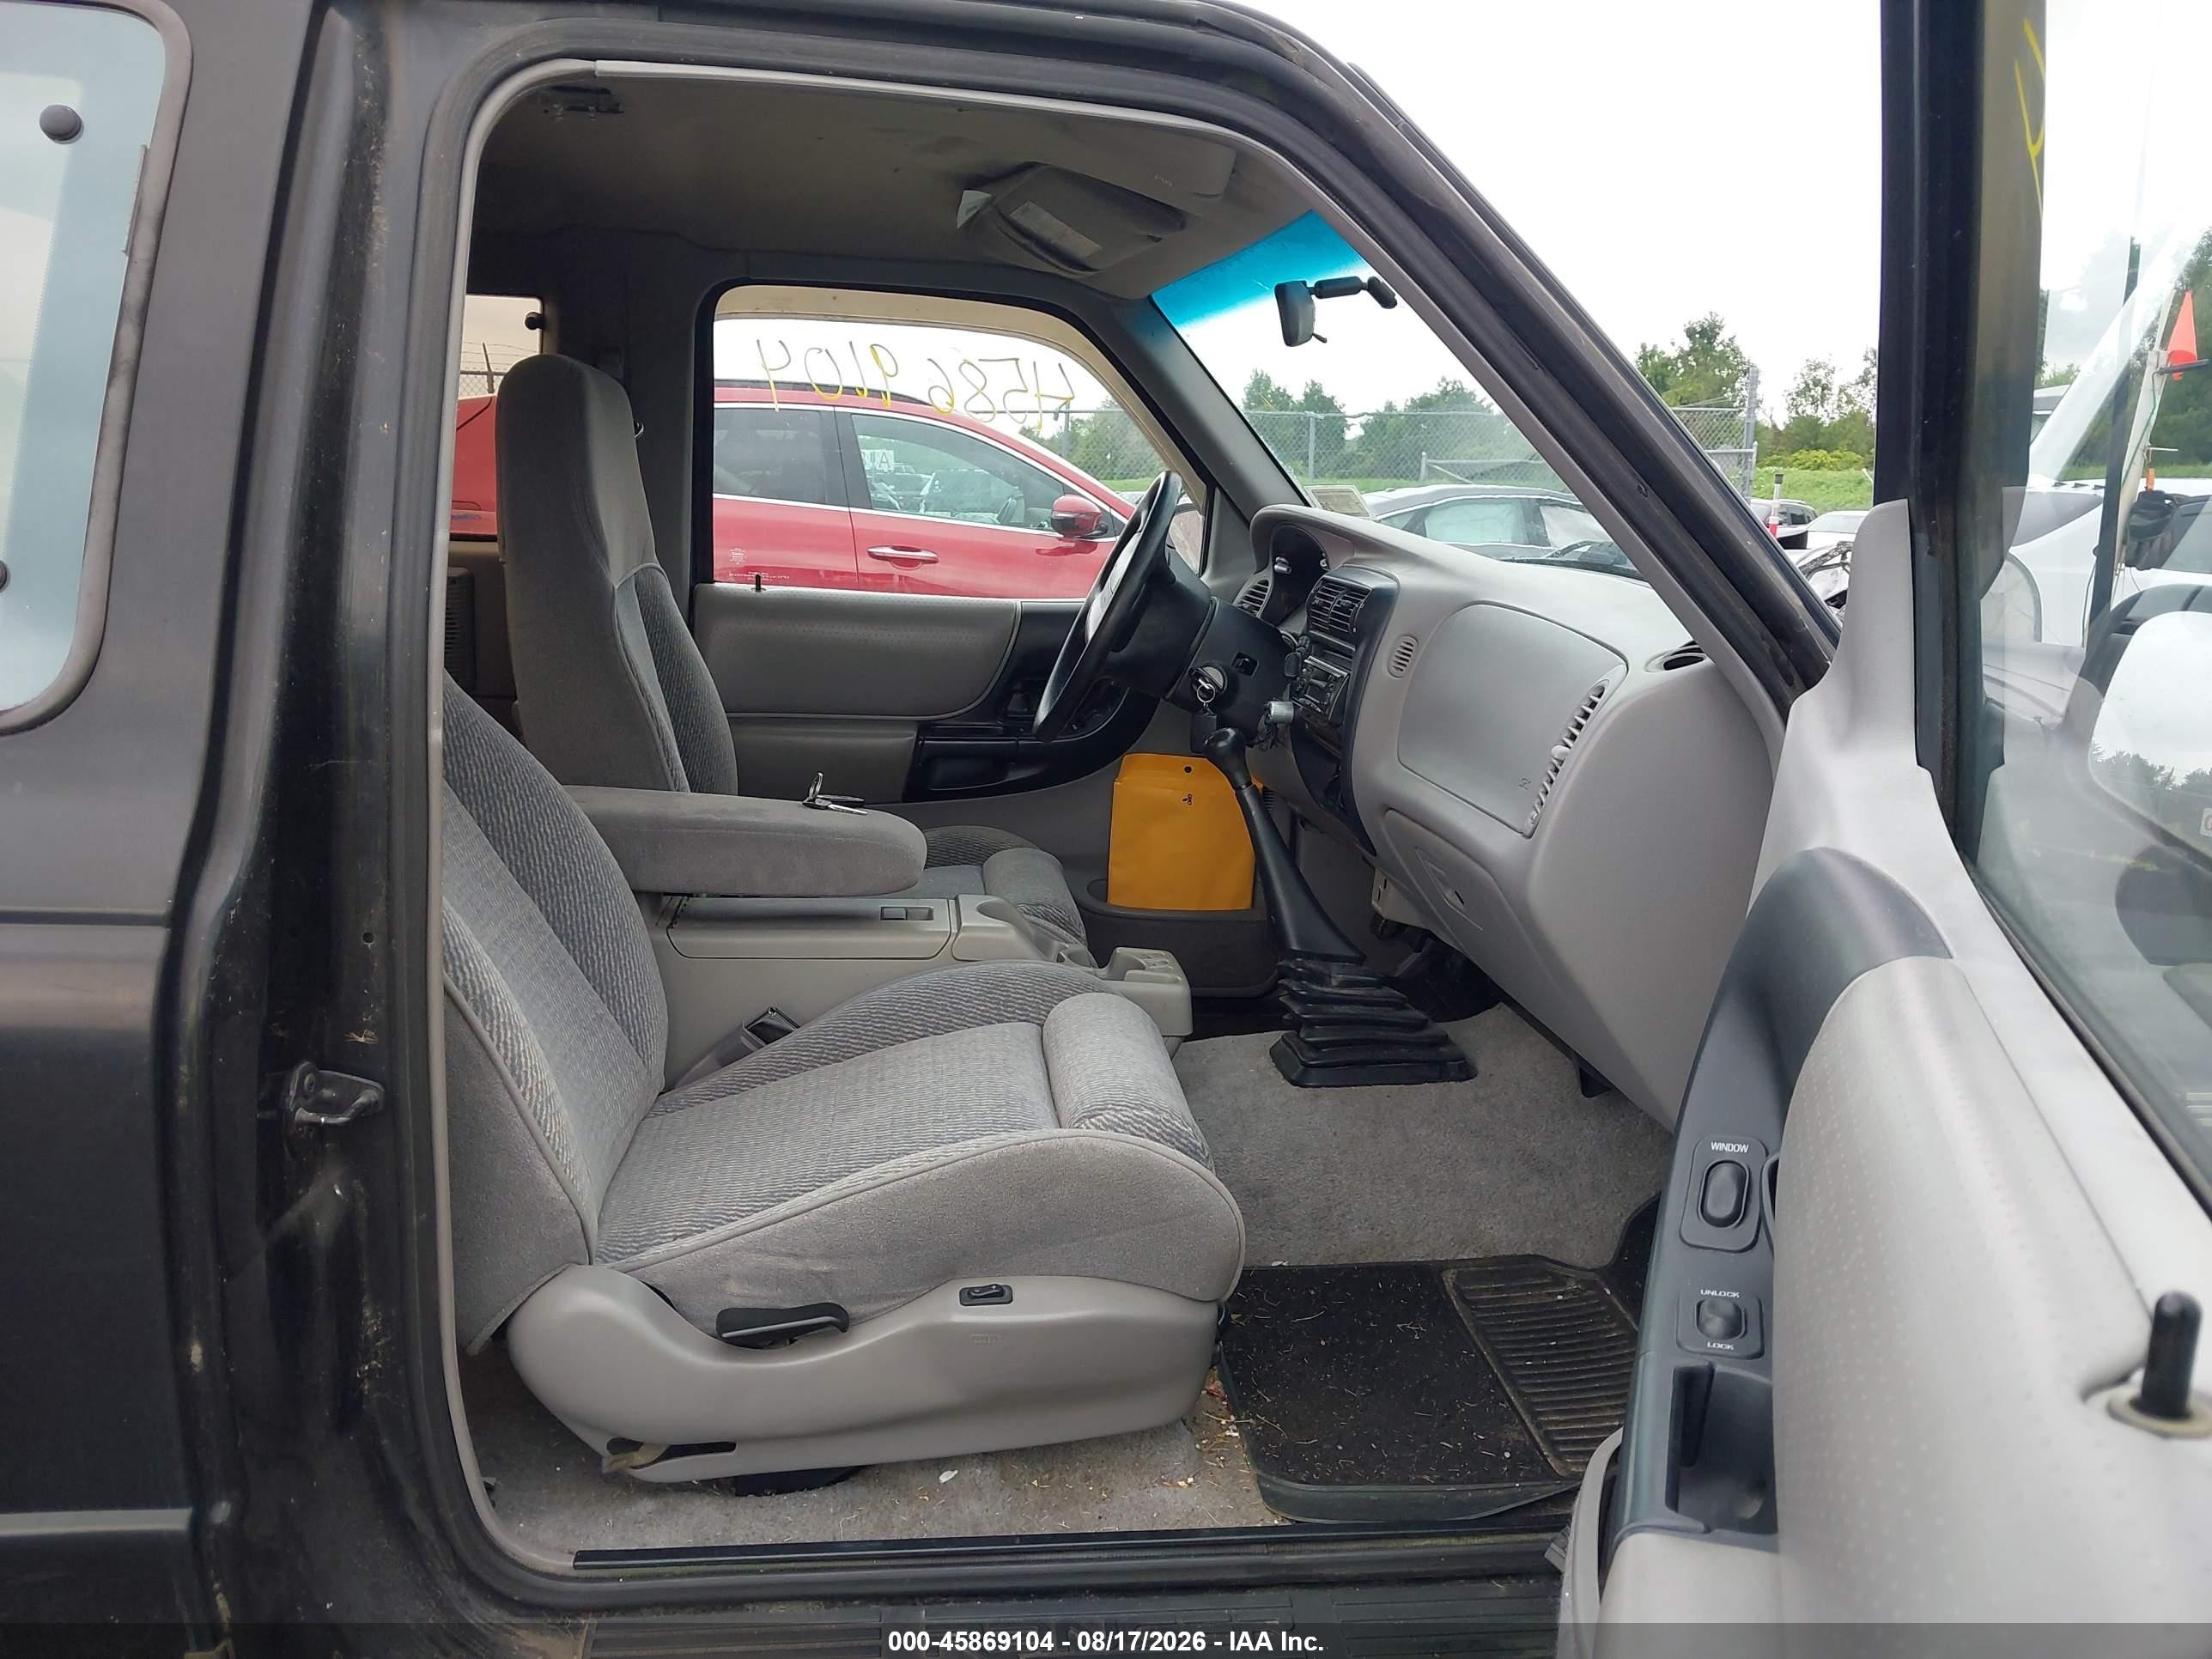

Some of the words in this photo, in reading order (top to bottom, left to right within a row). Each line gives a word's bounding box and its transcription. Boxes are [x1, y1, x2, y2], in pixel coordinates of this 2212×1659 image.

[1711, 1140, 1749, 1154] WINDOW
[1700, 1289, 1741, 1299] UNLOCK
[1706, 1341, 1735, 1352] LOCK
